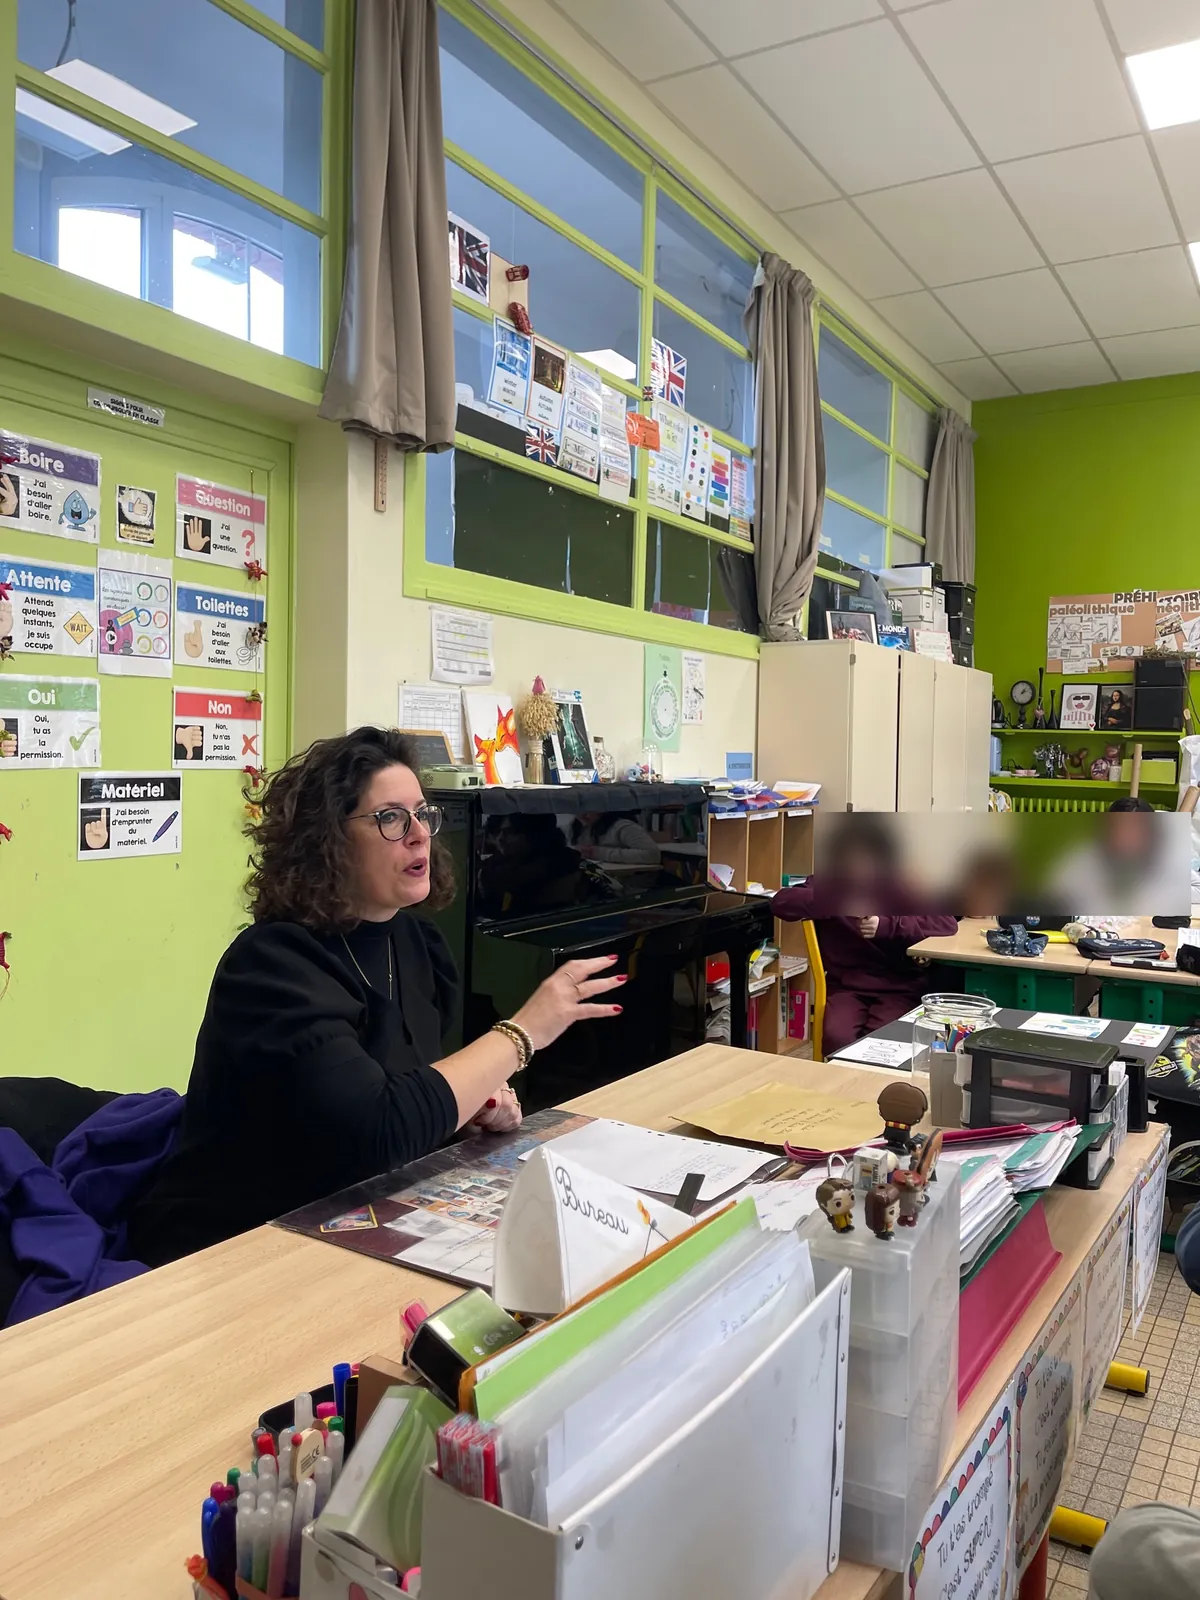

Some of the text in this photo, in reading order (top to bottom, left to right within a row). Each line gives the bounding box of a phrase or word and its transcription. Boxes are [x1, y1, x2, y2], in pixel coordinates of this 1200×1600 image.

[20, 448, 64, 473] Boire
[33, 479, 46, 488] J'ai
[27, 488, 52, 500] besoin
[27, 499, 52, 510] d'aller
[195, 489, 251, 517] Question
[28, 510, 52, 521] boire.
[220, 523, 230, 531] J'ai
[212, 543, 237, 553] question.
[6, 569, 72, 593] Attente
[24, 597, 54, 607] Attends
[195, 595, 249, 617] Toilettes
[22, 608, 56, 618] quelques
[1049, 603, 1134, 618] paléolithique
[24, 618, 54, 628] instants,
[70, 622, 87, 632] WAIT
[212, 630, 230, 638] besoin
[883, 625, 907, 633] MONDE
[27, 630, 35, 639] je
[212, 639, 230, 647] d'aller
[28, 688, 55, 705] Oui
[208, 699, 232, 715] Non
[34, 715, 49, 723] Oui,
[33, 727, 40, 735] tu
[20, 750, 64, 760] permission.
[101, 782, 164, 799] Matériel
[112, 818, 152, 826] d'emprunter
[555, 1166, 629, 1235] Bureau
[937, 1541, 948, 1568] Tu
